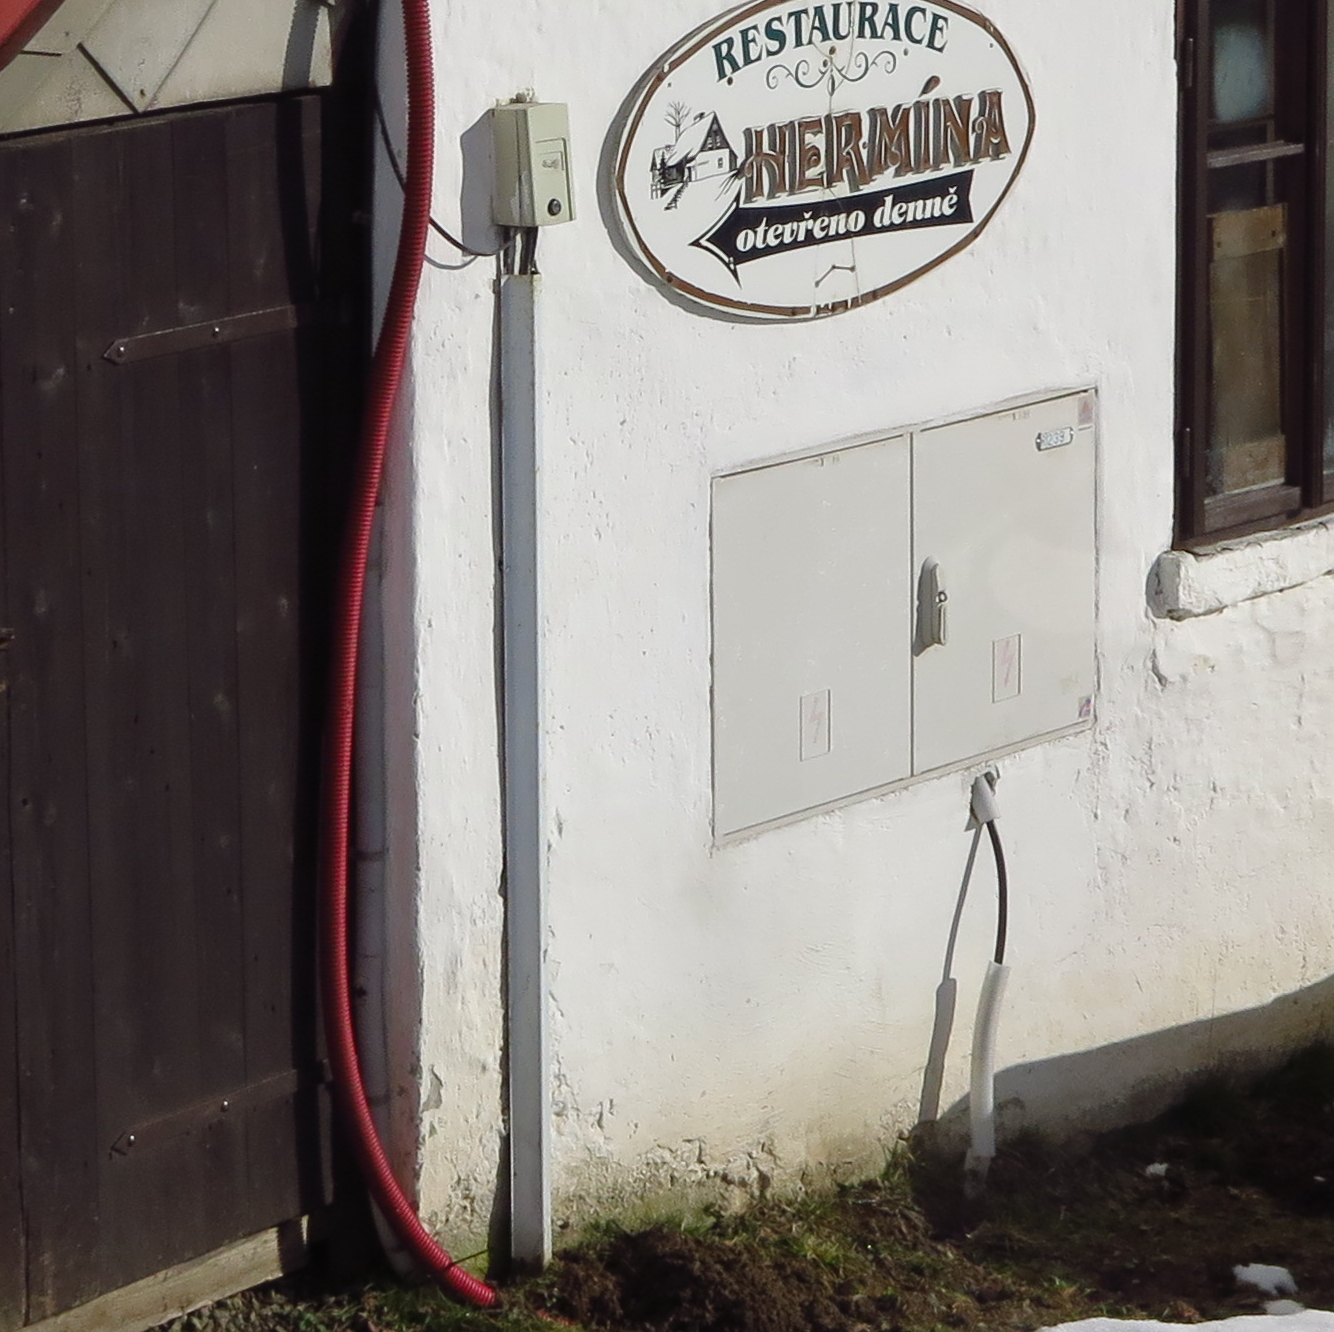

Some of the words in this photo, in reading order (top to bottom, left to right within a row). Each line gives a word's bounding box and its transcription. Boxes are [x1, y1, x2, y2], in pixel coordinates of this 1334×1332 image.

[712, 1, 949, 82] RESTAURACE
[743, 76, 1012, 204] HERMÍNA
[735, 211, 866, 252] otevřeno
[872, 187, 959, 226] denně
